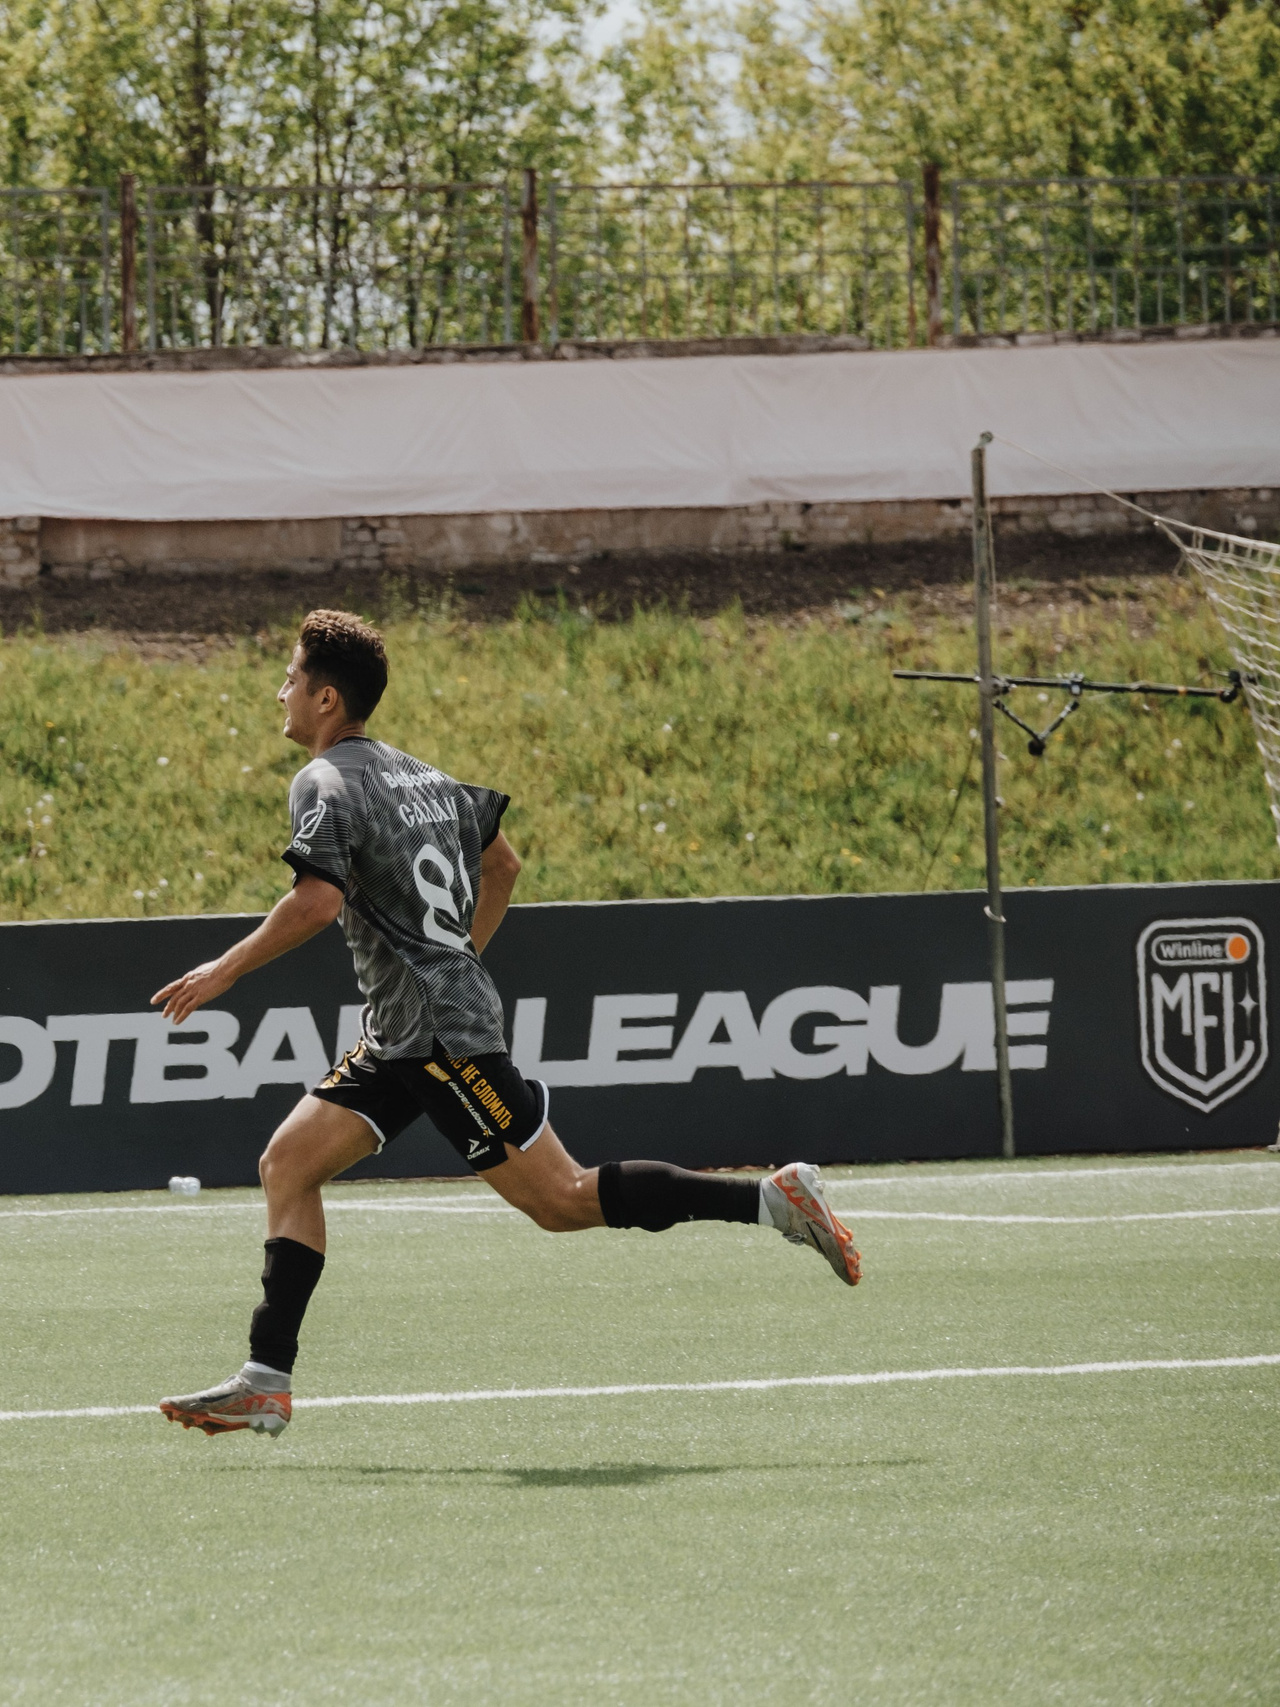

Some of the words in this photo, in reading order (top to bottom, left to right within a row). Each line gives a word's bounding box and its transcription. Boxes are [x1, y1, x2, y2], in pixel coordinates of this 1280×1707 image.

[1160, 941, 1224, 960] Winline
[510, 978, 1055, 1088] LEAGUE
[1151, 971, 1256, 1097] MFL
[460, 1063, 480, 1084] НЕ
[471, 1078, 513, 1130] СЛОМАТЬ
[467, 1145, 491, 1160] DEMIX
